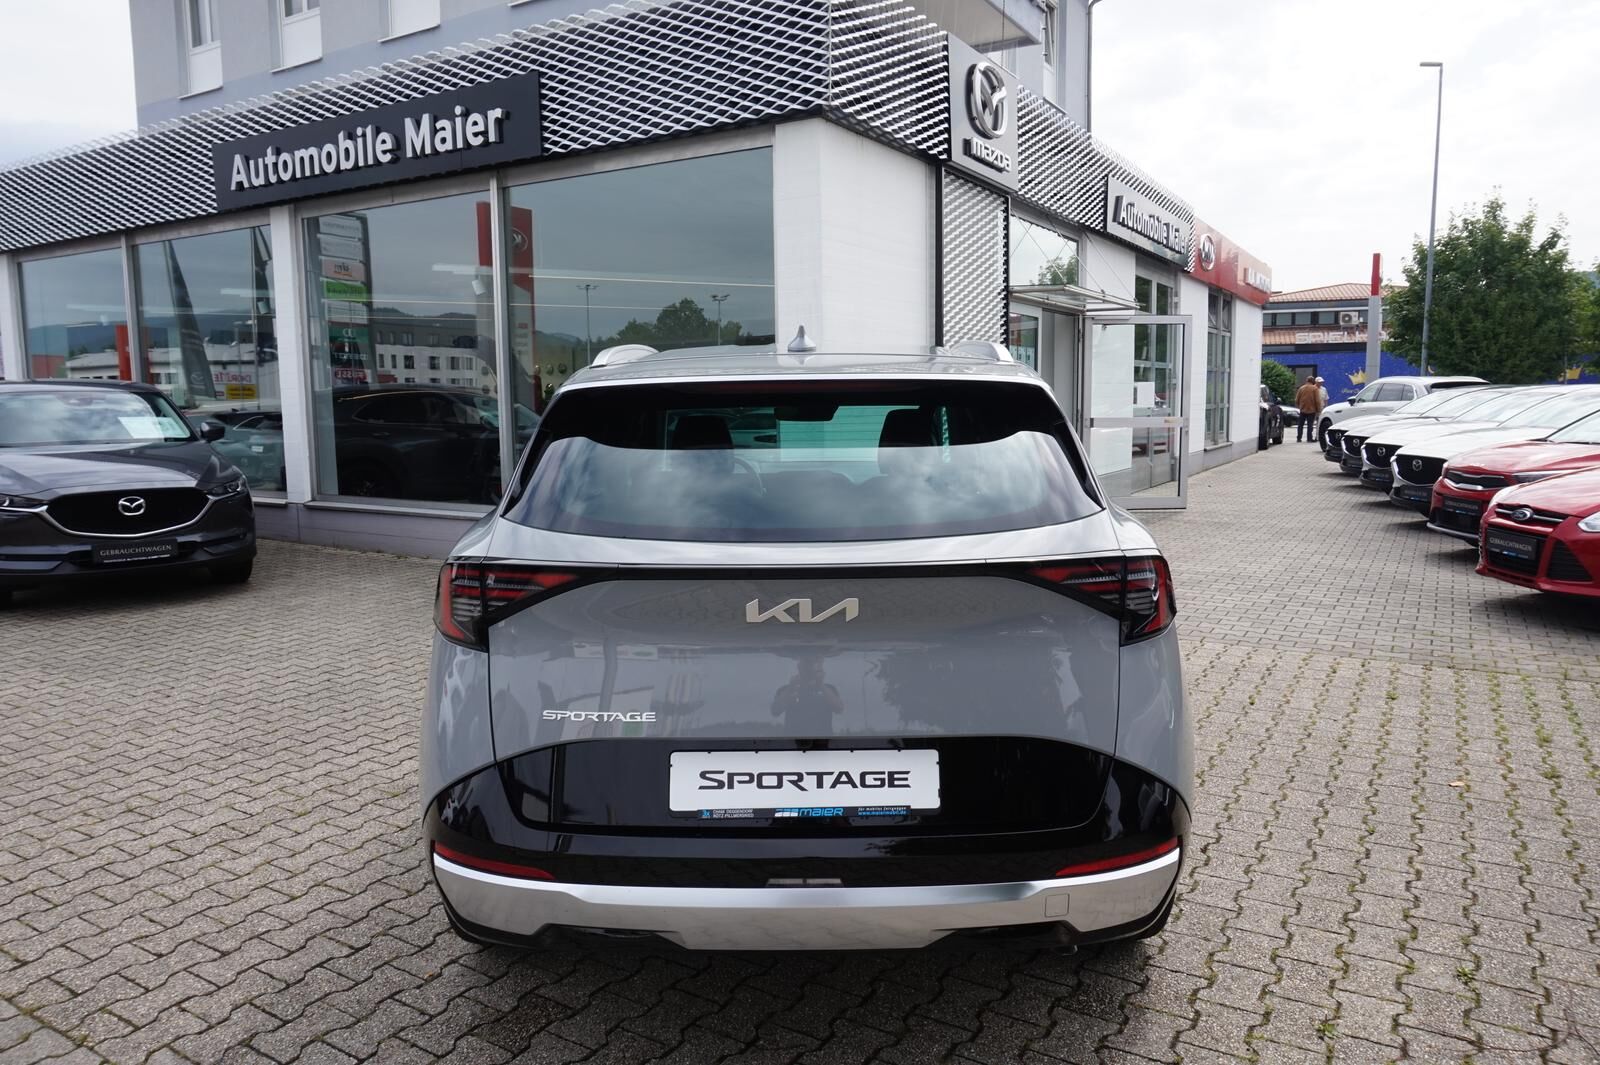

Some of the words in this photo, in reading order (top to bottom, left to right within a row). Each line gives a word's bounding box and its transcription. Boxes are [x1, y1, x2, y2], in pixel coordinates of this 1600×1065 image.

[230, 124, 393, 191] Automobile
[404, 105, 503, 158] Maier
[972, 137, 1012, 173] mazda
[1119, 195, 1168, 245] Automobile
[1169, 224, 1188, 255] Maier
[100, 545, 172, 556] GEBRAUCHTWAGEN
[745, 597, 859, 623] KIA
[542, 709, 657, 723] SPORTAGE
[698, 769, 911, 791] SPORTAGE
